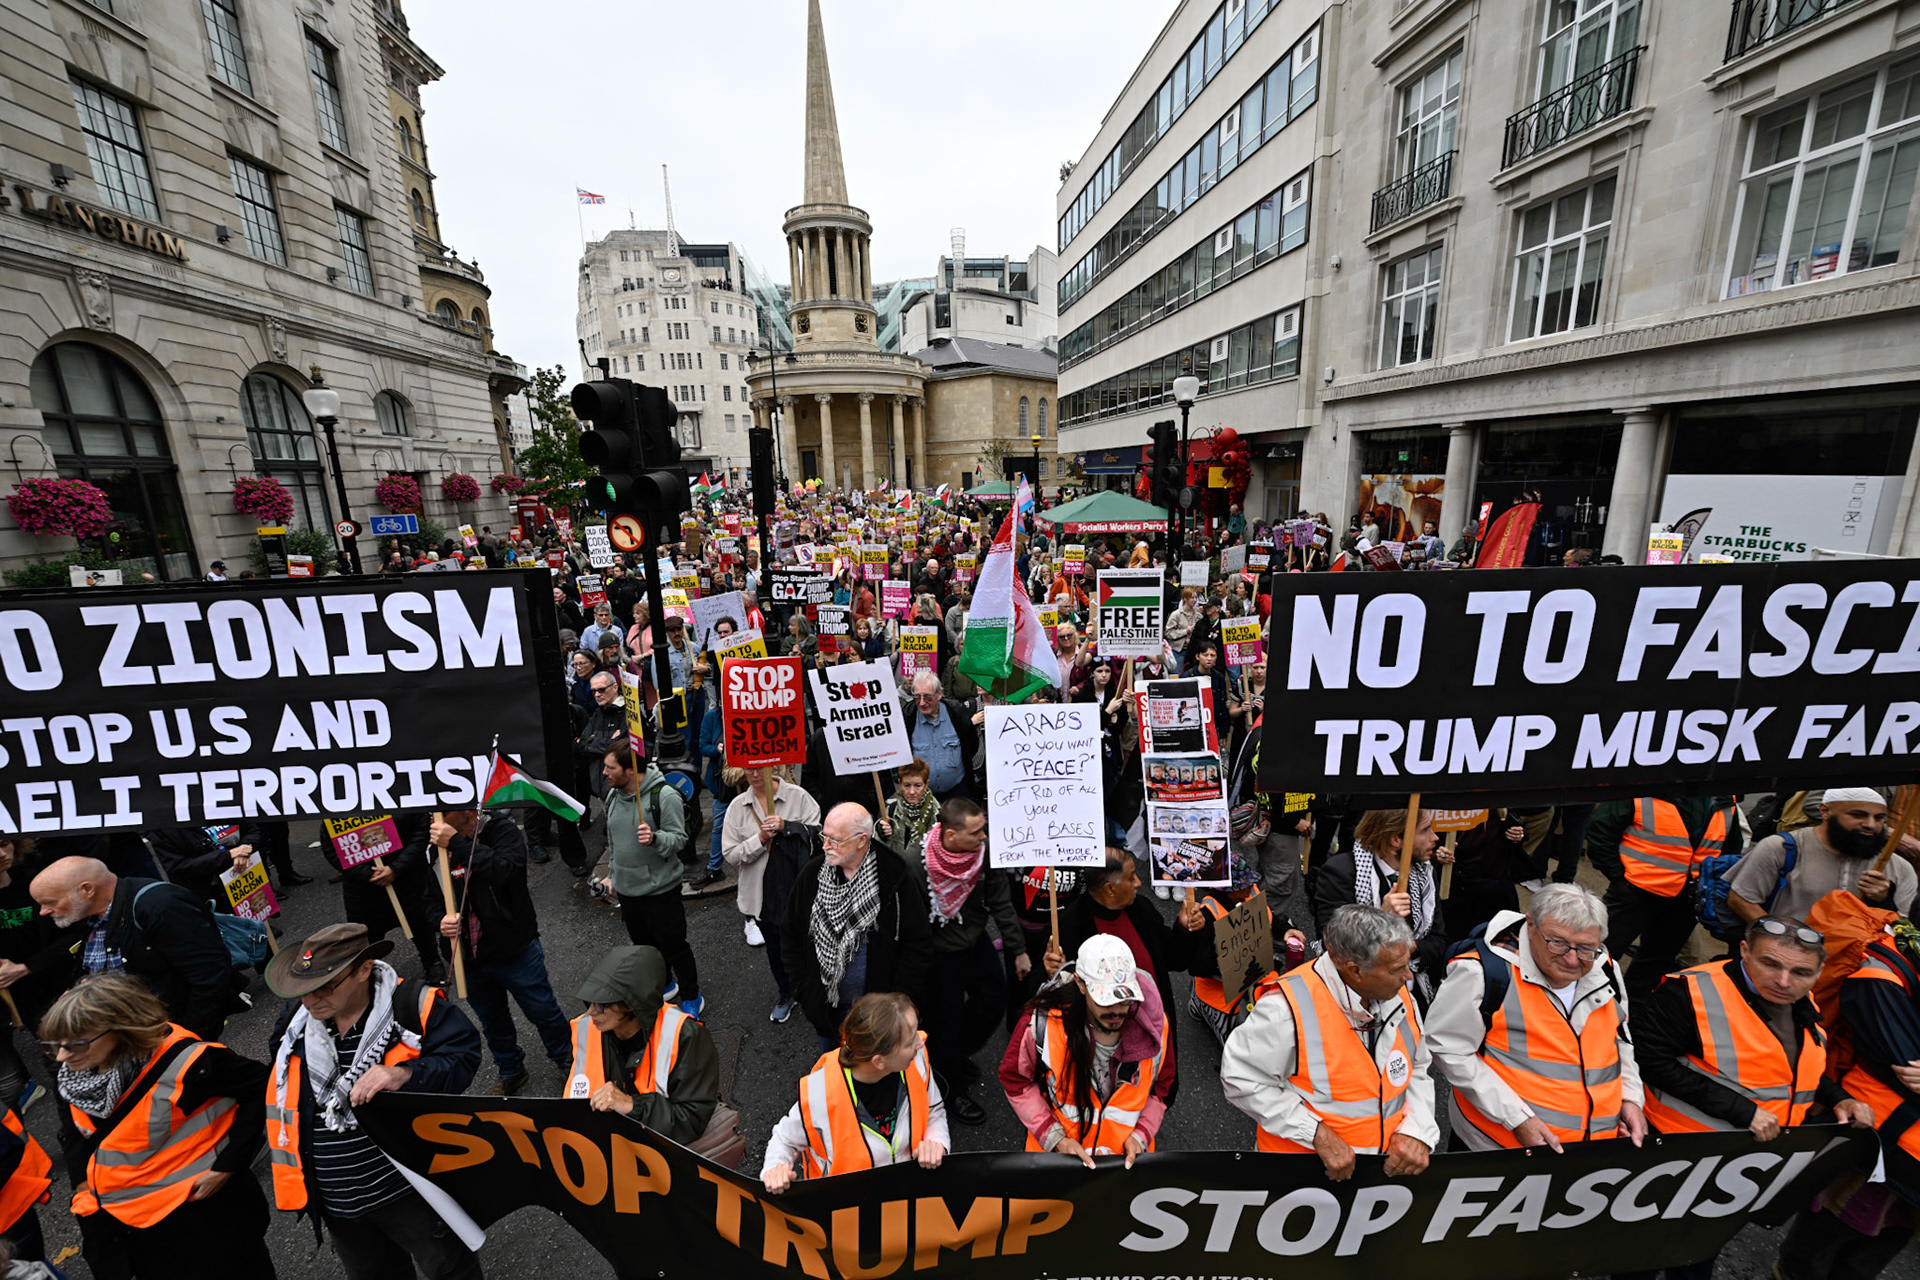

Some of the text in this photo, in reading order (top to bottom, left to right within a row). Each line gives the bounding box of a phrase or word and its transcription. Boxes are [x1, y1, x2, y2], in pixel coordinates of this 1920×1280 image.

[14, 184, 190, 262] LANGHAM
[1078, 522, 1163, 531] Socialist Workers Party
[1740, 525, 1772, 537] THE
[1704, 535, 1807, 553] STARBUCKS
[1719, 549, 1781, 561] COFFEE
[807, 582, 829, 593] DUMP
[807, 592, 833, 604] TRUMP
[819, 611, 844, 623] DUMP
[1100, 608, 1159, 628] FREE
[80, 587, 524, 687] ZIONISM
[819, 623, 849, 634] TRUMP
[1100, 629, 1159, 638] PALESTINE
[1226, 633, 1256, 642] RACISM
[1227, 644, 1238, 652] NO
[1287, 592, 1426, 690] NO
[1465, 589, 1596, 686] TO
[738, 645, 752, 656] TO
[1228, 656, 1257, 665] TRUMP
[729, 665, 794, 691] STOP
[729, 688, 796, 710] TRUMP
[830, 702, 891, 723] Arming
[0, 699, 391, 767] TOP U.S AND
[732, 715, 796, 740] STOP
[836, 718, 892, 742] Israel
[999, 711, 1082, 740] ARABS
[732, 738, 798, 755] FASCISM
[1014, 743, 1031, 755] DO
[1067, 738, 1094, 750] WANT
[1314, 714, 1557, 776] TRUMP
[1571, 706, 1778, 770] MUSK
[994, 787, 1026, 807] GET
[1031, 785, 1053, 800] RID
[1059, 785, 1074, 798] OF
[1284, 802, 1309, 813] NUKES
[338, 832, 359, 847] NO
[1003, 821, 1095, 844] USA BASES
[341, 842, 362, 855] TO
[345, 841, 392, 869] TRUMP
[999, 849, 1052, 863] FROM THE
[228, 872, 254, 892] NO TO
[232, 877, 263, 902] RACISM
[237, 900, 250, 914] NO
[1228, 906, 1251, 929] We
[1233, 936, 1262, 972] your
[411, 1111, 1074, 1280] STOP TRUMP
[1118, 1185, 1412, 1256] STOP
